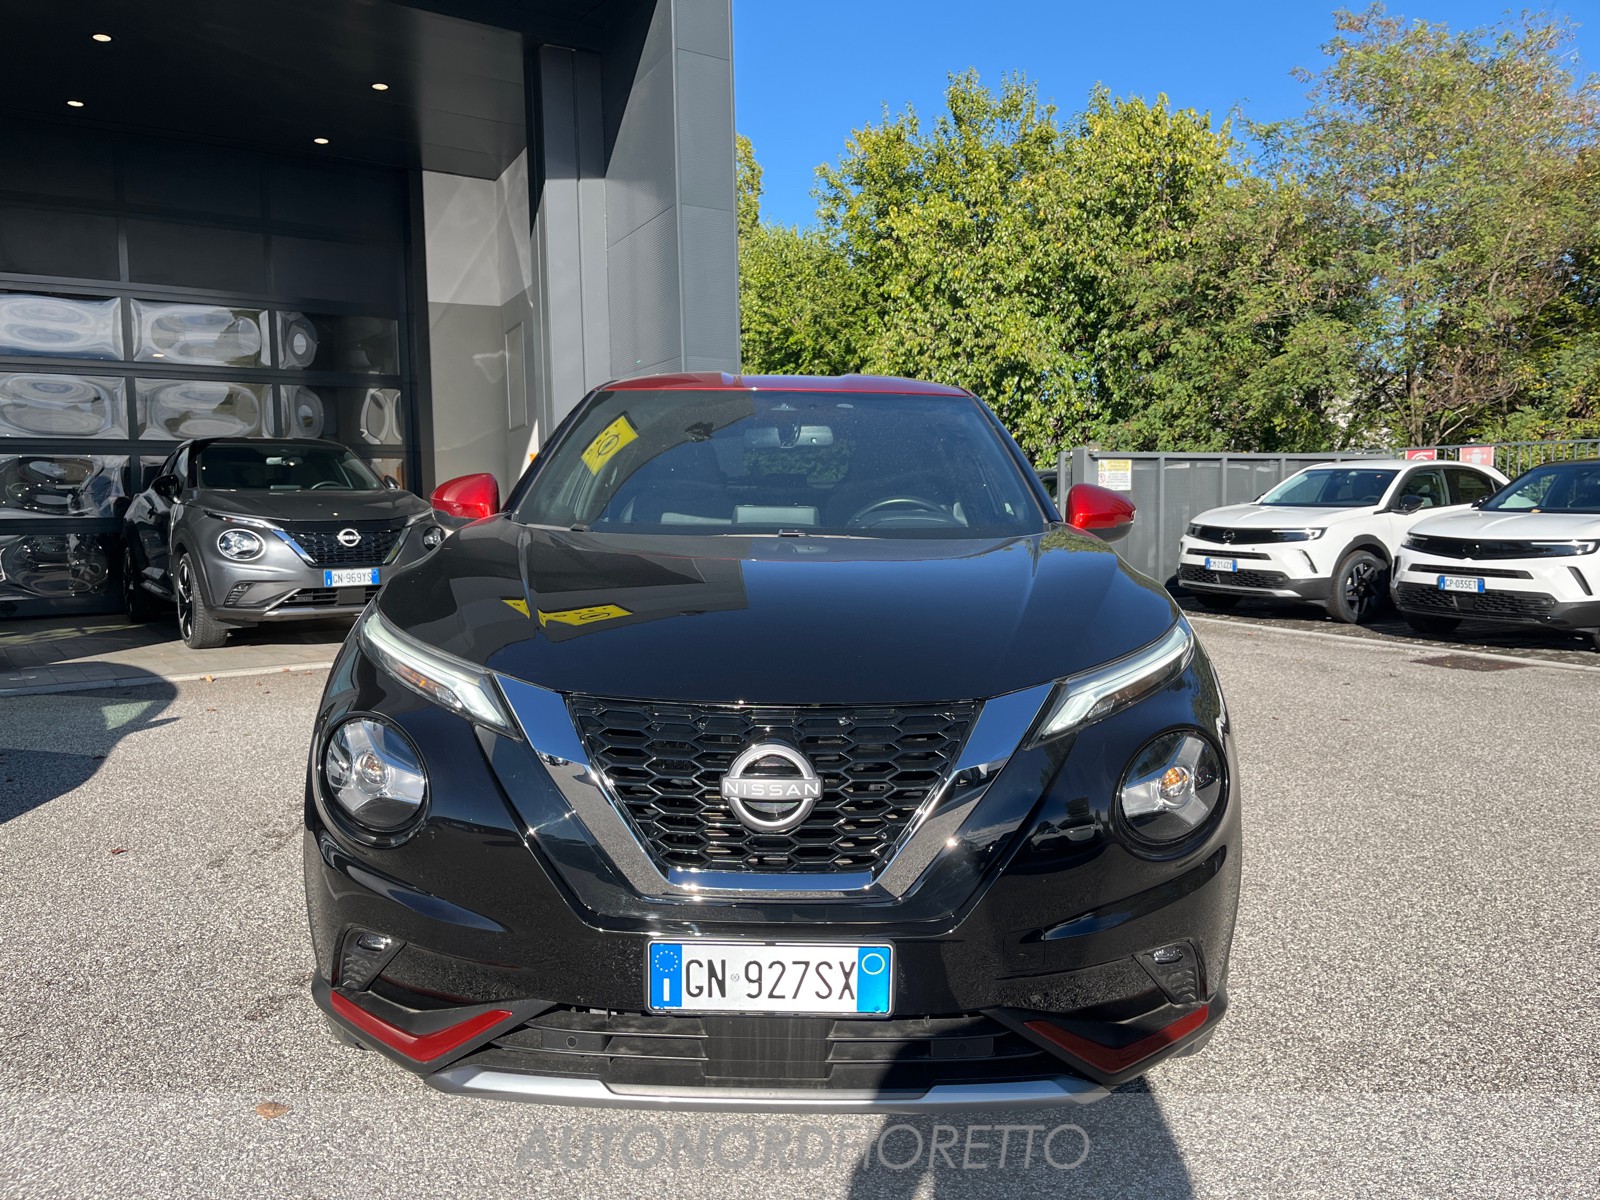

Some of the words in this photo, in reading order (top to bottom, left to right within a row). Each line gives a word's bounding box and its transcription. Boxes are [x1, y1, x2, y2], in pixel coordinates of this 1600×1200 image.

[725, 781, 819, 796] NISSAN
[685, 959, 727, 999] GN
[744, 960, 856, 1000] 927SX
